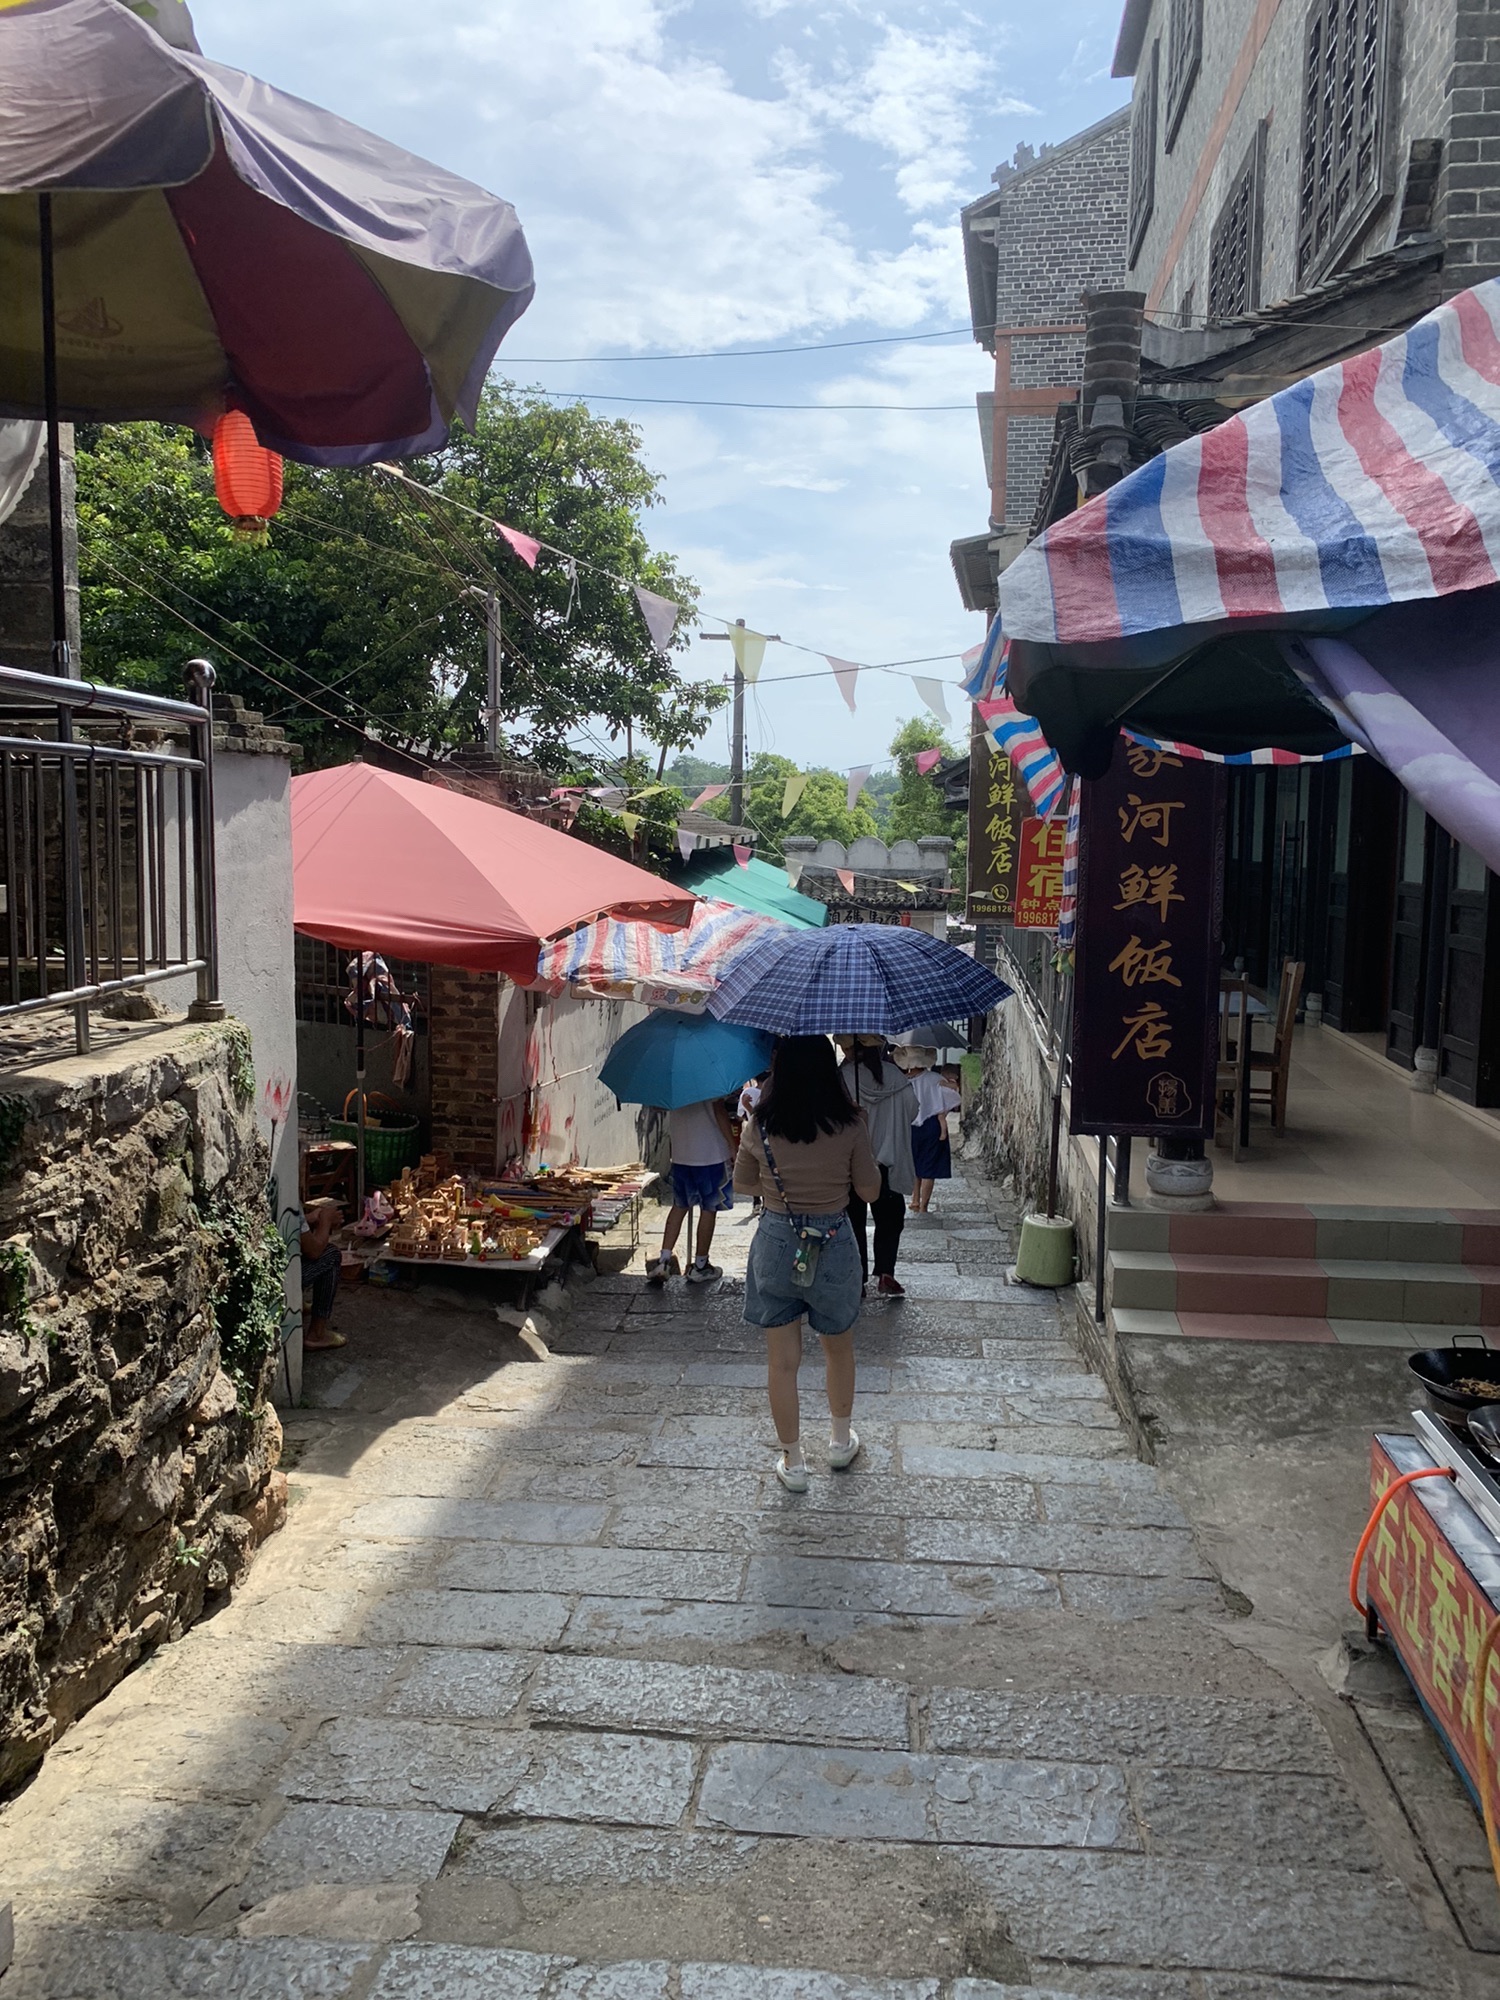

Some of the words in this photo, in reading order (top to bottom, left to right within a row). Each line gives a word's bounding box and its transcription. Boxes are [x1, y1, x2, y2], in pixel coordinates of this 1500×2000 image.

[984, 750, 1018, 875] 河鲜饭店
[971, 904, 1015, 913] 19968128
